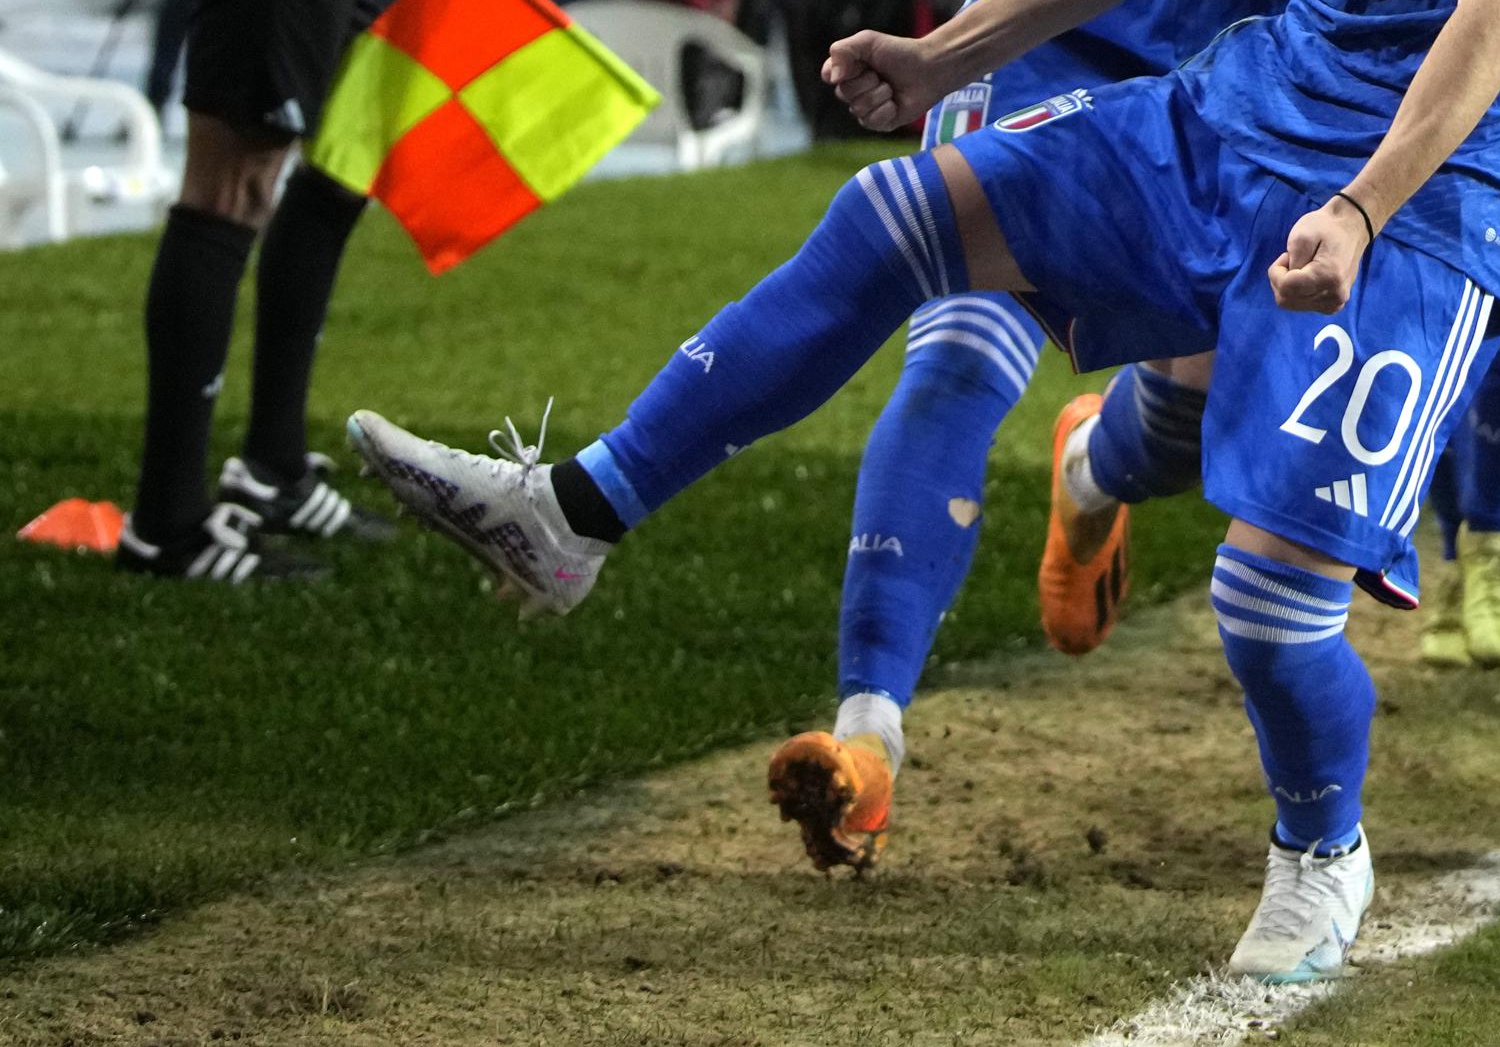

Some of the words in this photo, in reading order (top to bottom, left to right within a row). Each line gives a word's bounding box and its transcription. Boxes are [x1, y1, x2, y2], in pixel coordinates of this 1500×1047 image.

[680, 336, 714, 373] LIA
[1279, 323, 1422, 466] 20
[848, 533, 903, 557] ALIA
[1275, 784, 1343, 803] ALIA
